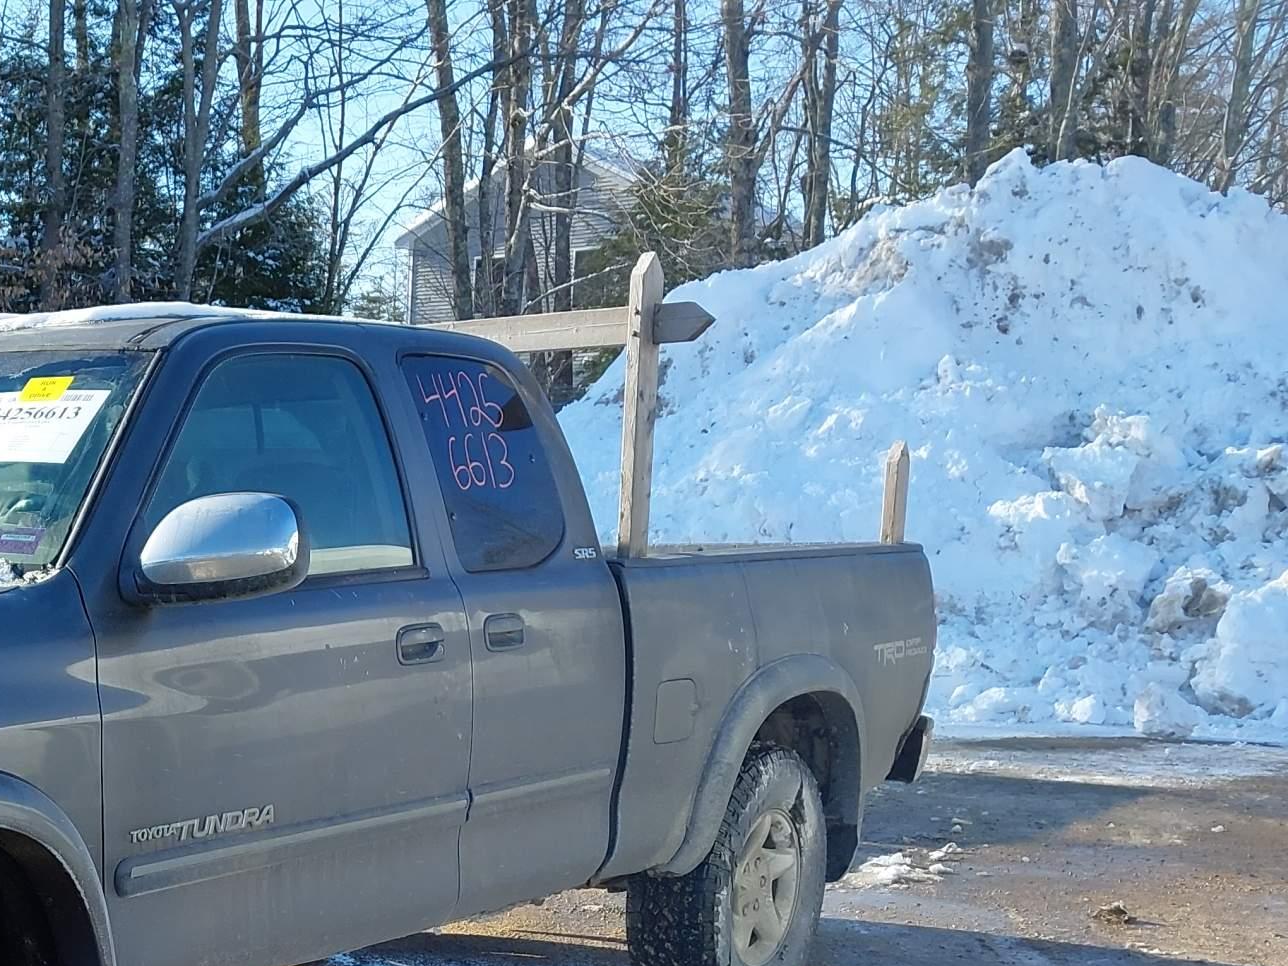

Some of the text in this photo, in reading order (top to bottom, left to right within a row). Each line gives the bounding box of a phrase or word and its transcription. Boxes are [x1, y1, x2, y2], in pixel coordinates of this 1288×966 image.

[416, 371, 504, 428] 4425
[448, 432, 515, 490] 6613
[574, 547, 597, 559] SR5
[873, 640, 905, 665] TRD
[130, 804, 275, 843] TOYOTA TUNDRA
